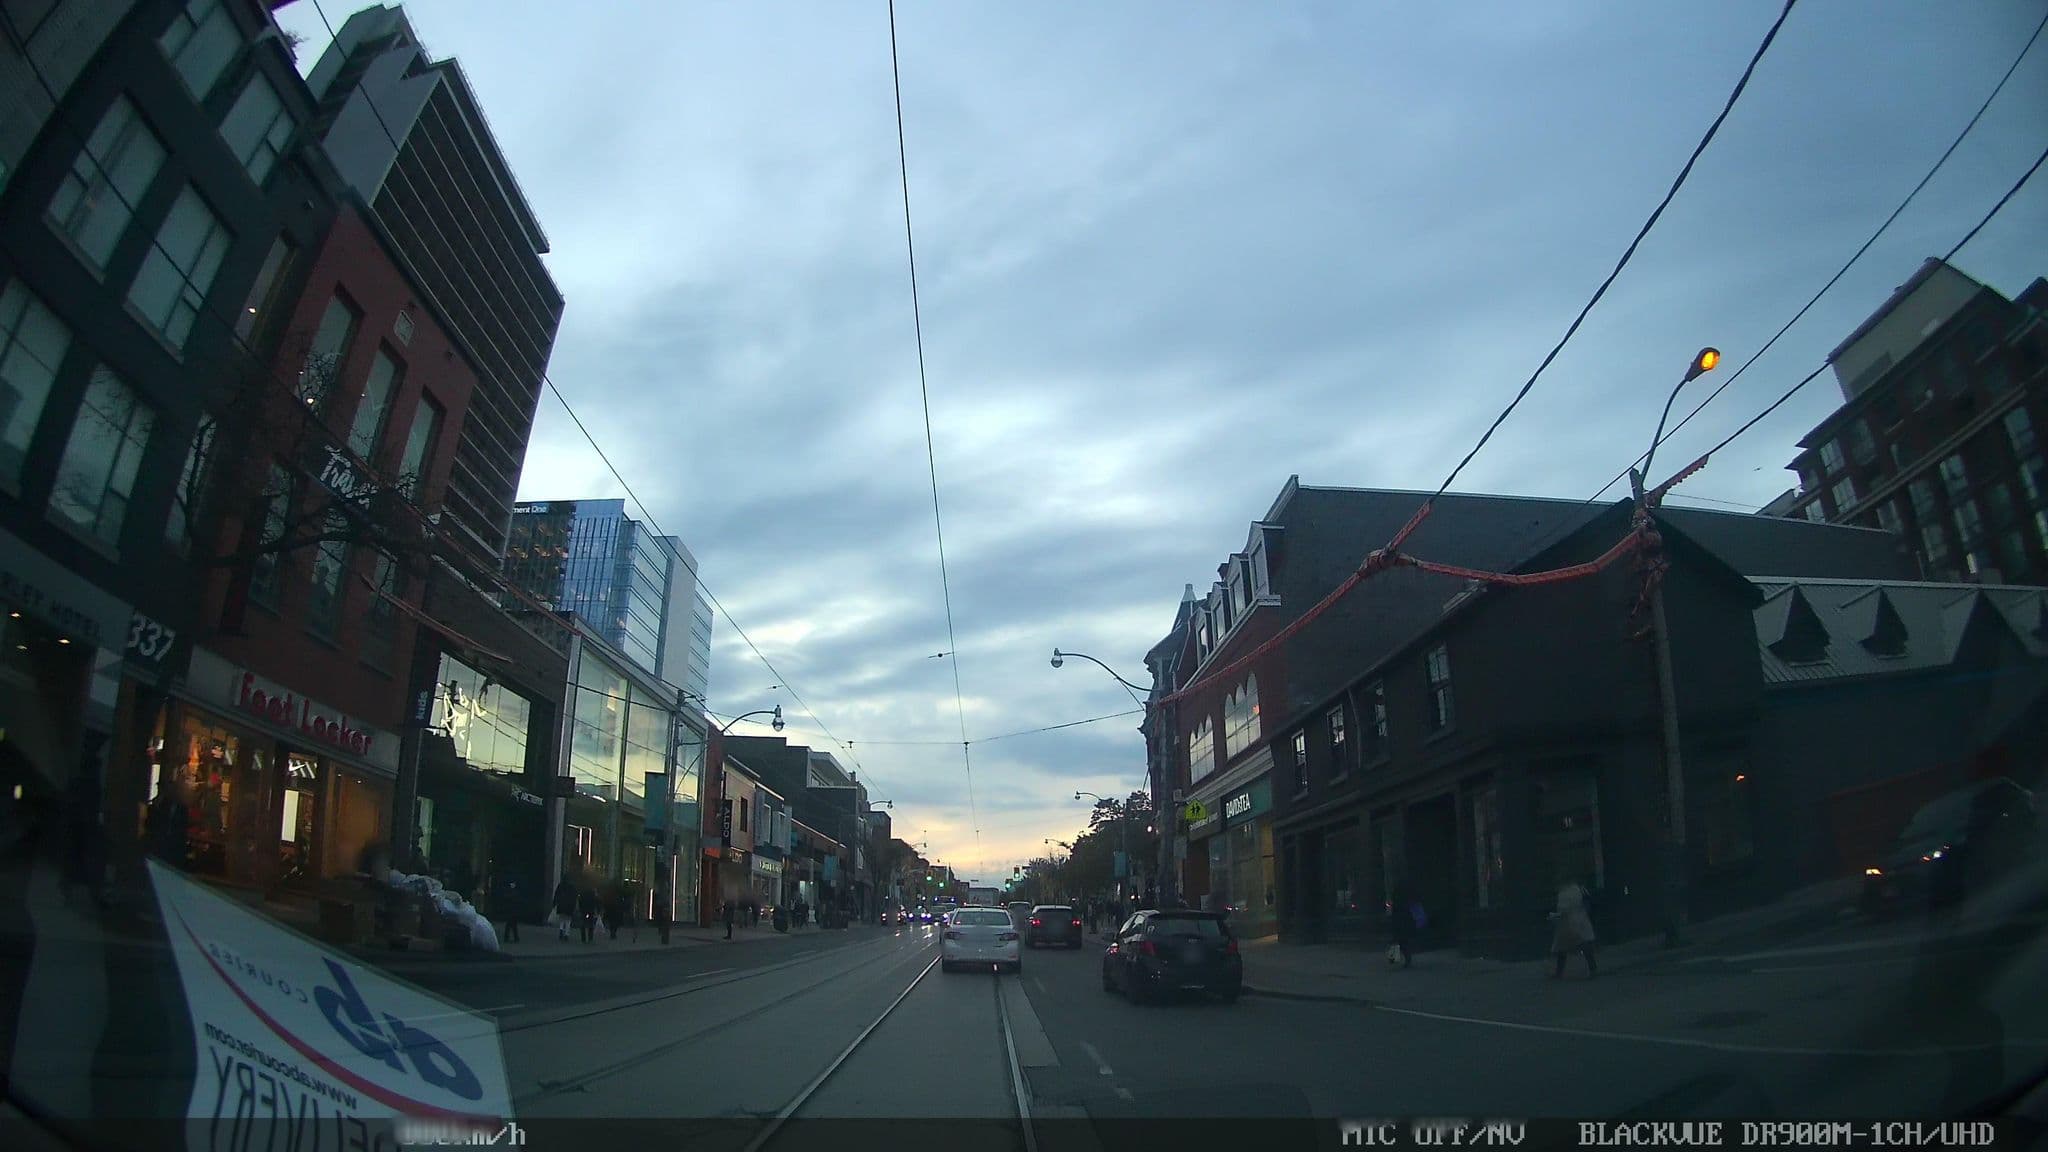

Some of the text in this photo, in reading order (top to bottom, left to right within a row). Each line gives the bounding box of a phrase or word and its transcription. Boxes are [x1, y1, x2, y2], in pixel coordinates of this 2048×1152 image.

[128, 611, 176, 662] 337
[240, 671, 372, 755] Foot Locker
